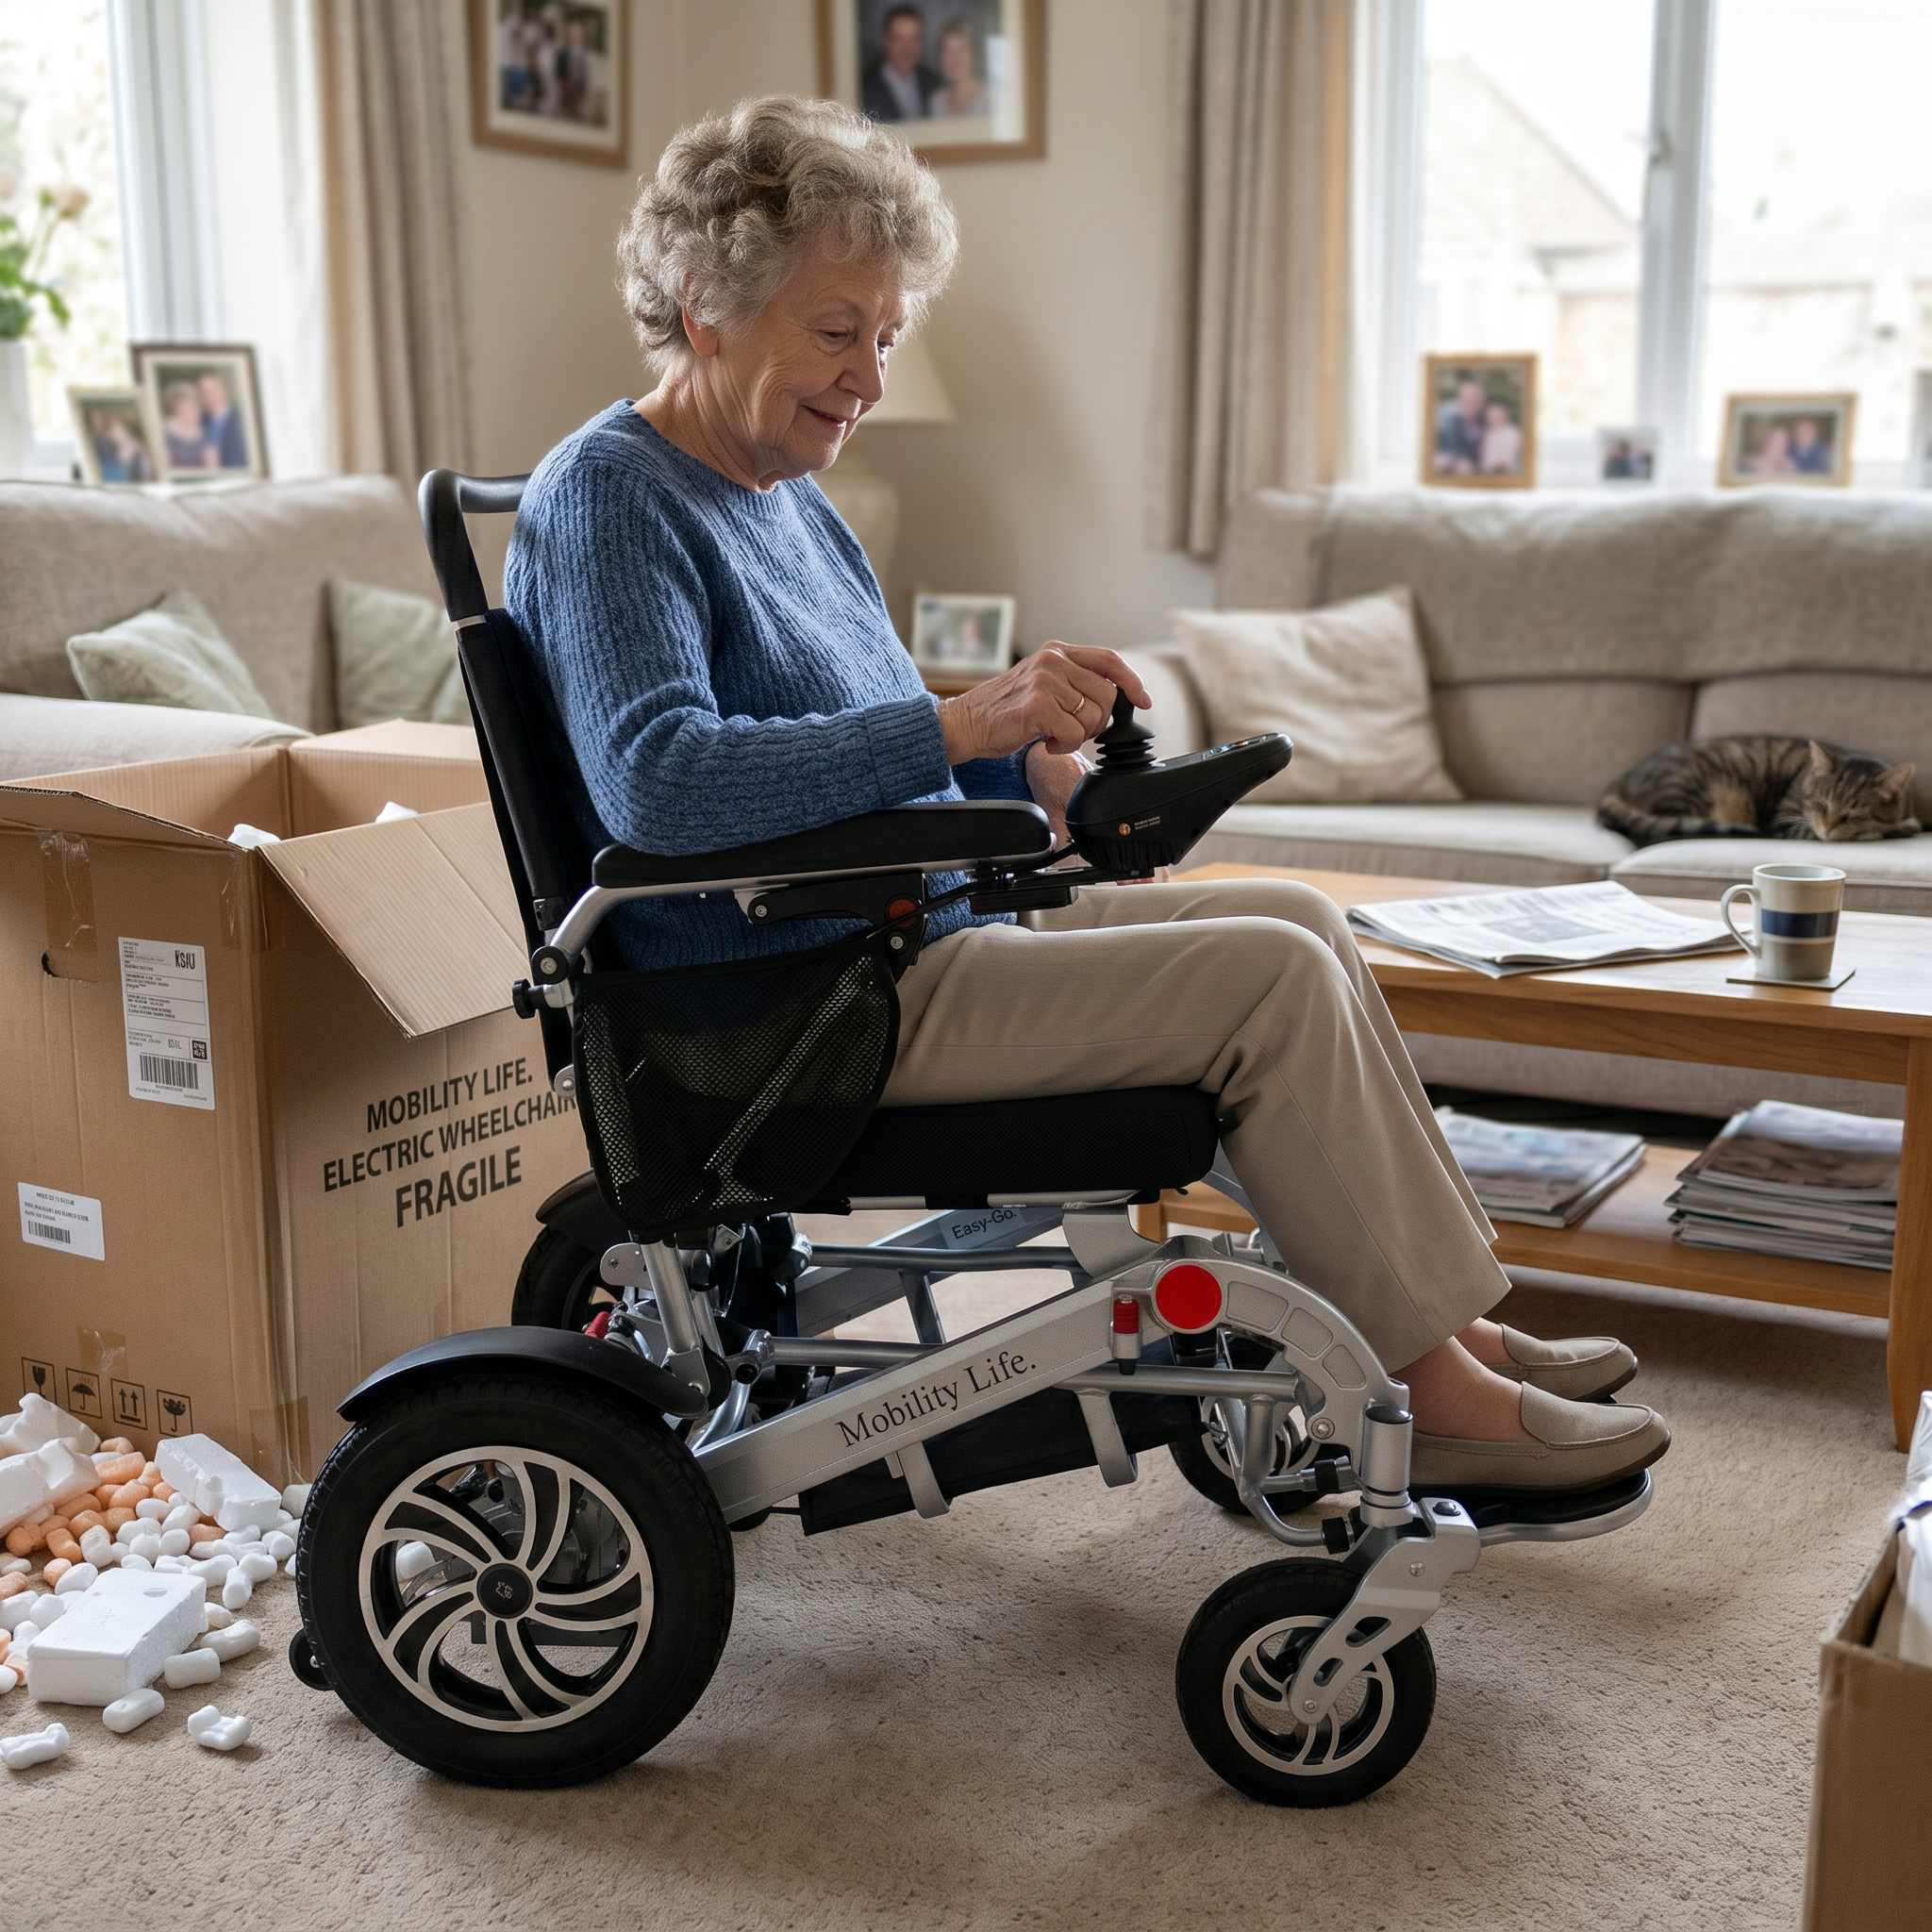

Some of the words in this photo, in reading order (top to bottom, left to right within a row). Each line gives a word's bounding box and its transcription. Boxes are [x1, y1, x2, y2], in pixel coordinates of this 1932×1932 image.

[367, 1072, 477, 1133] MOBILITY
[484, 1058, 532, 1095] LIFE.
[324, 1130, 434, 1192] ELECTRIC
[396, 1145, 522, 1228] FRAGILE
[952, 1209, 1017, 1240] Easy-Go.
[835, 1381, 958, 1447] Mobility
[963, 1351, 1036, 1393] Life.
